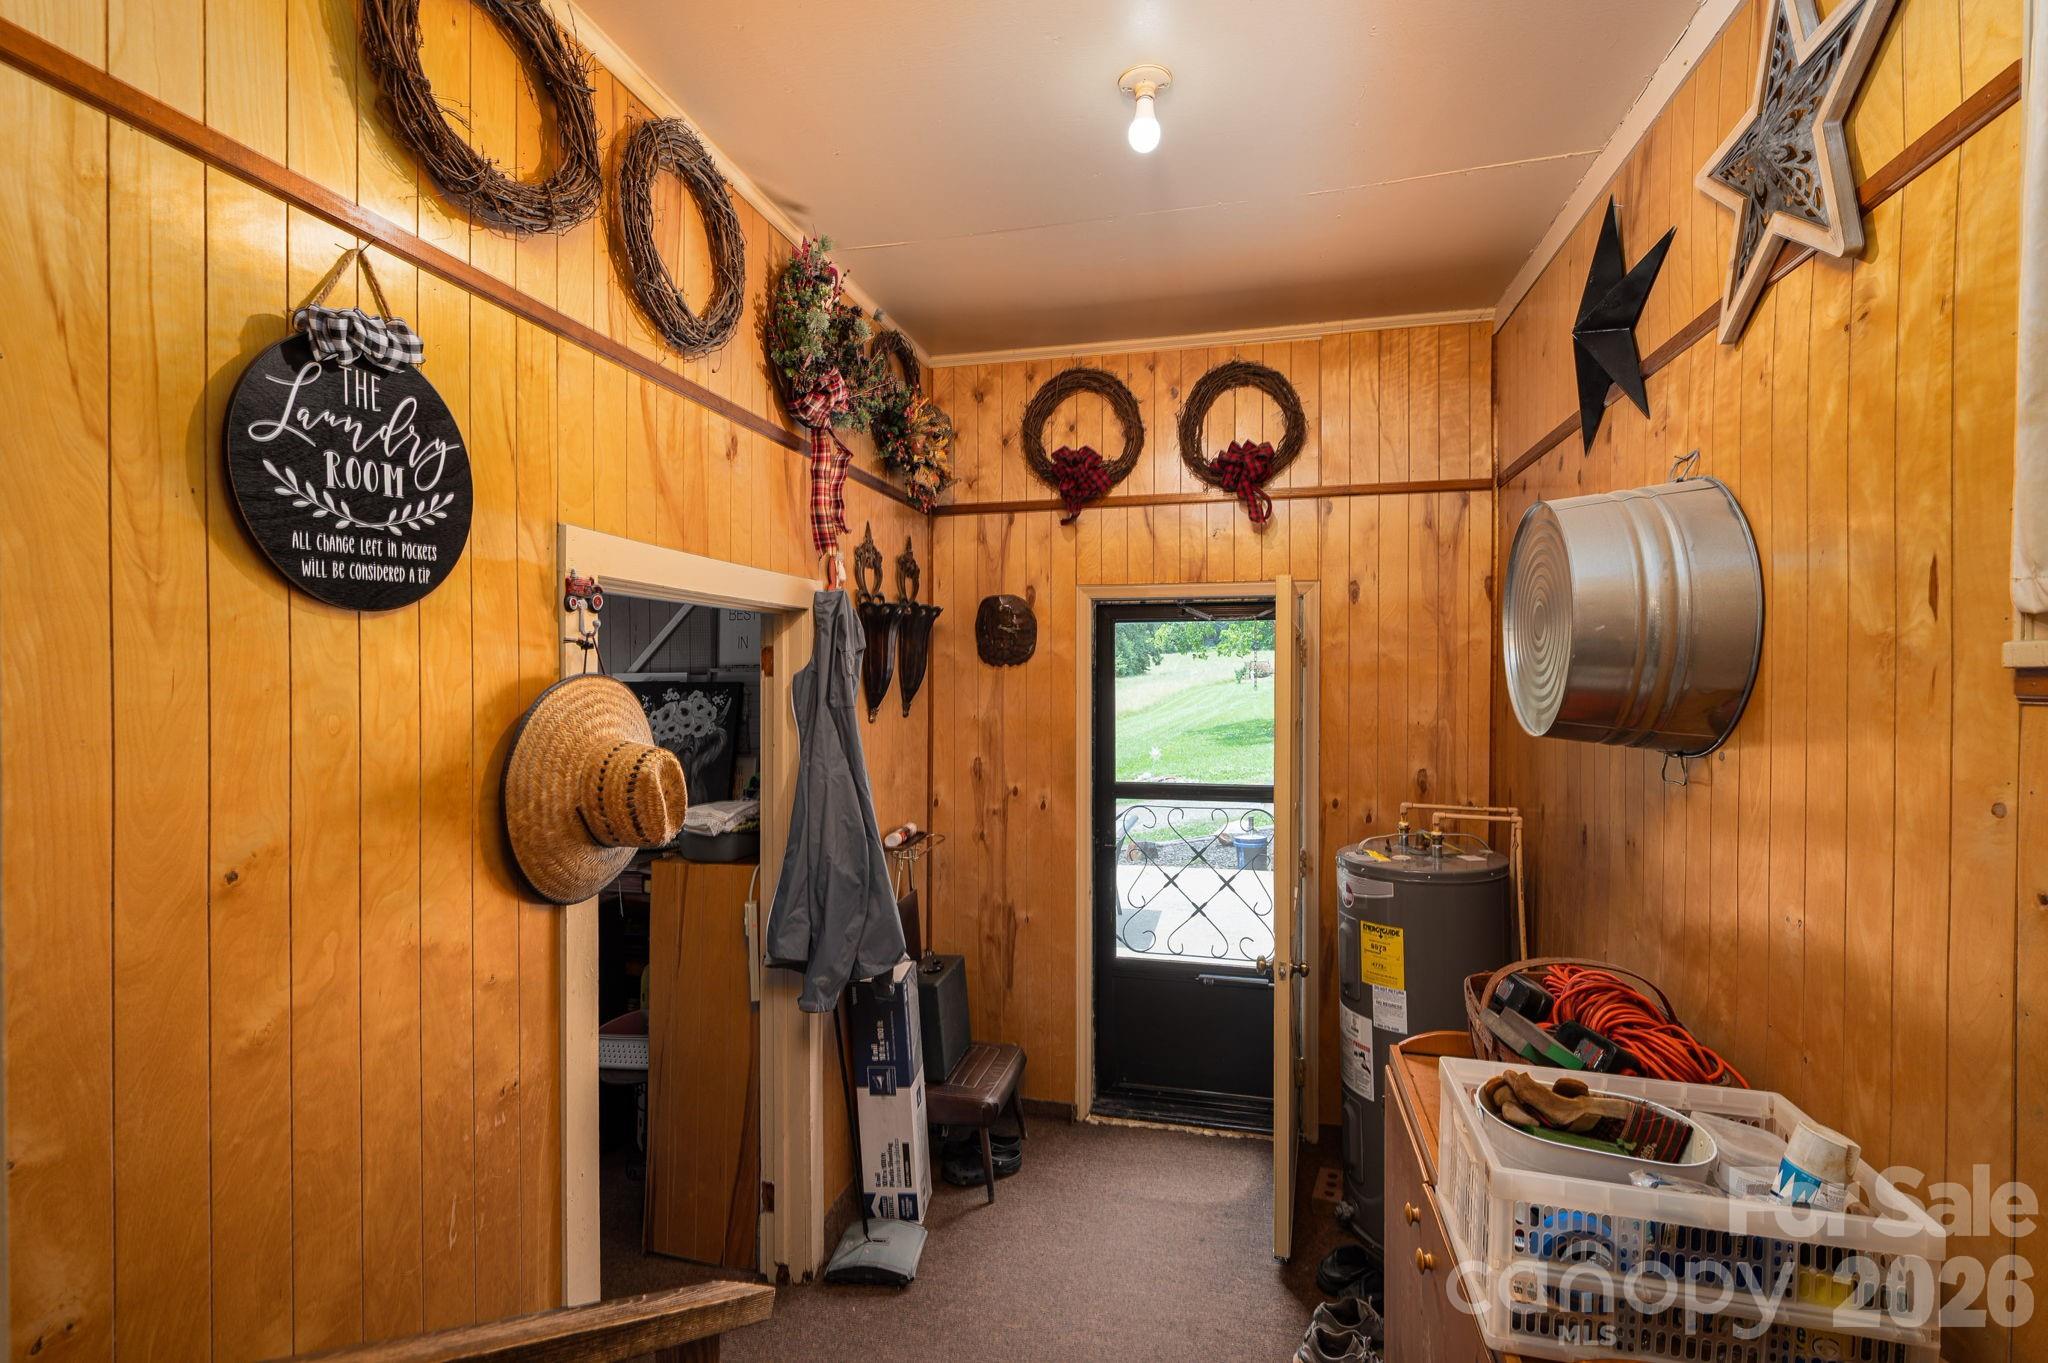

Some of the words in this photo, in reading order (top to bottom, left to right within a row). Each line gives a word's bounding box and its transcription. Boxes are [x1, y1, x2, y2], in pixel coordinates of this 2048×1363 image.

[338, 365, 382, 412] THE
[248, 362, 460, 491] Laundry
[323, 450, 405, 499] ROOM
[292, 530, 312, 551] ALL
[409, 566, 415, 583] A
[737, 635, 749, 649] IN
